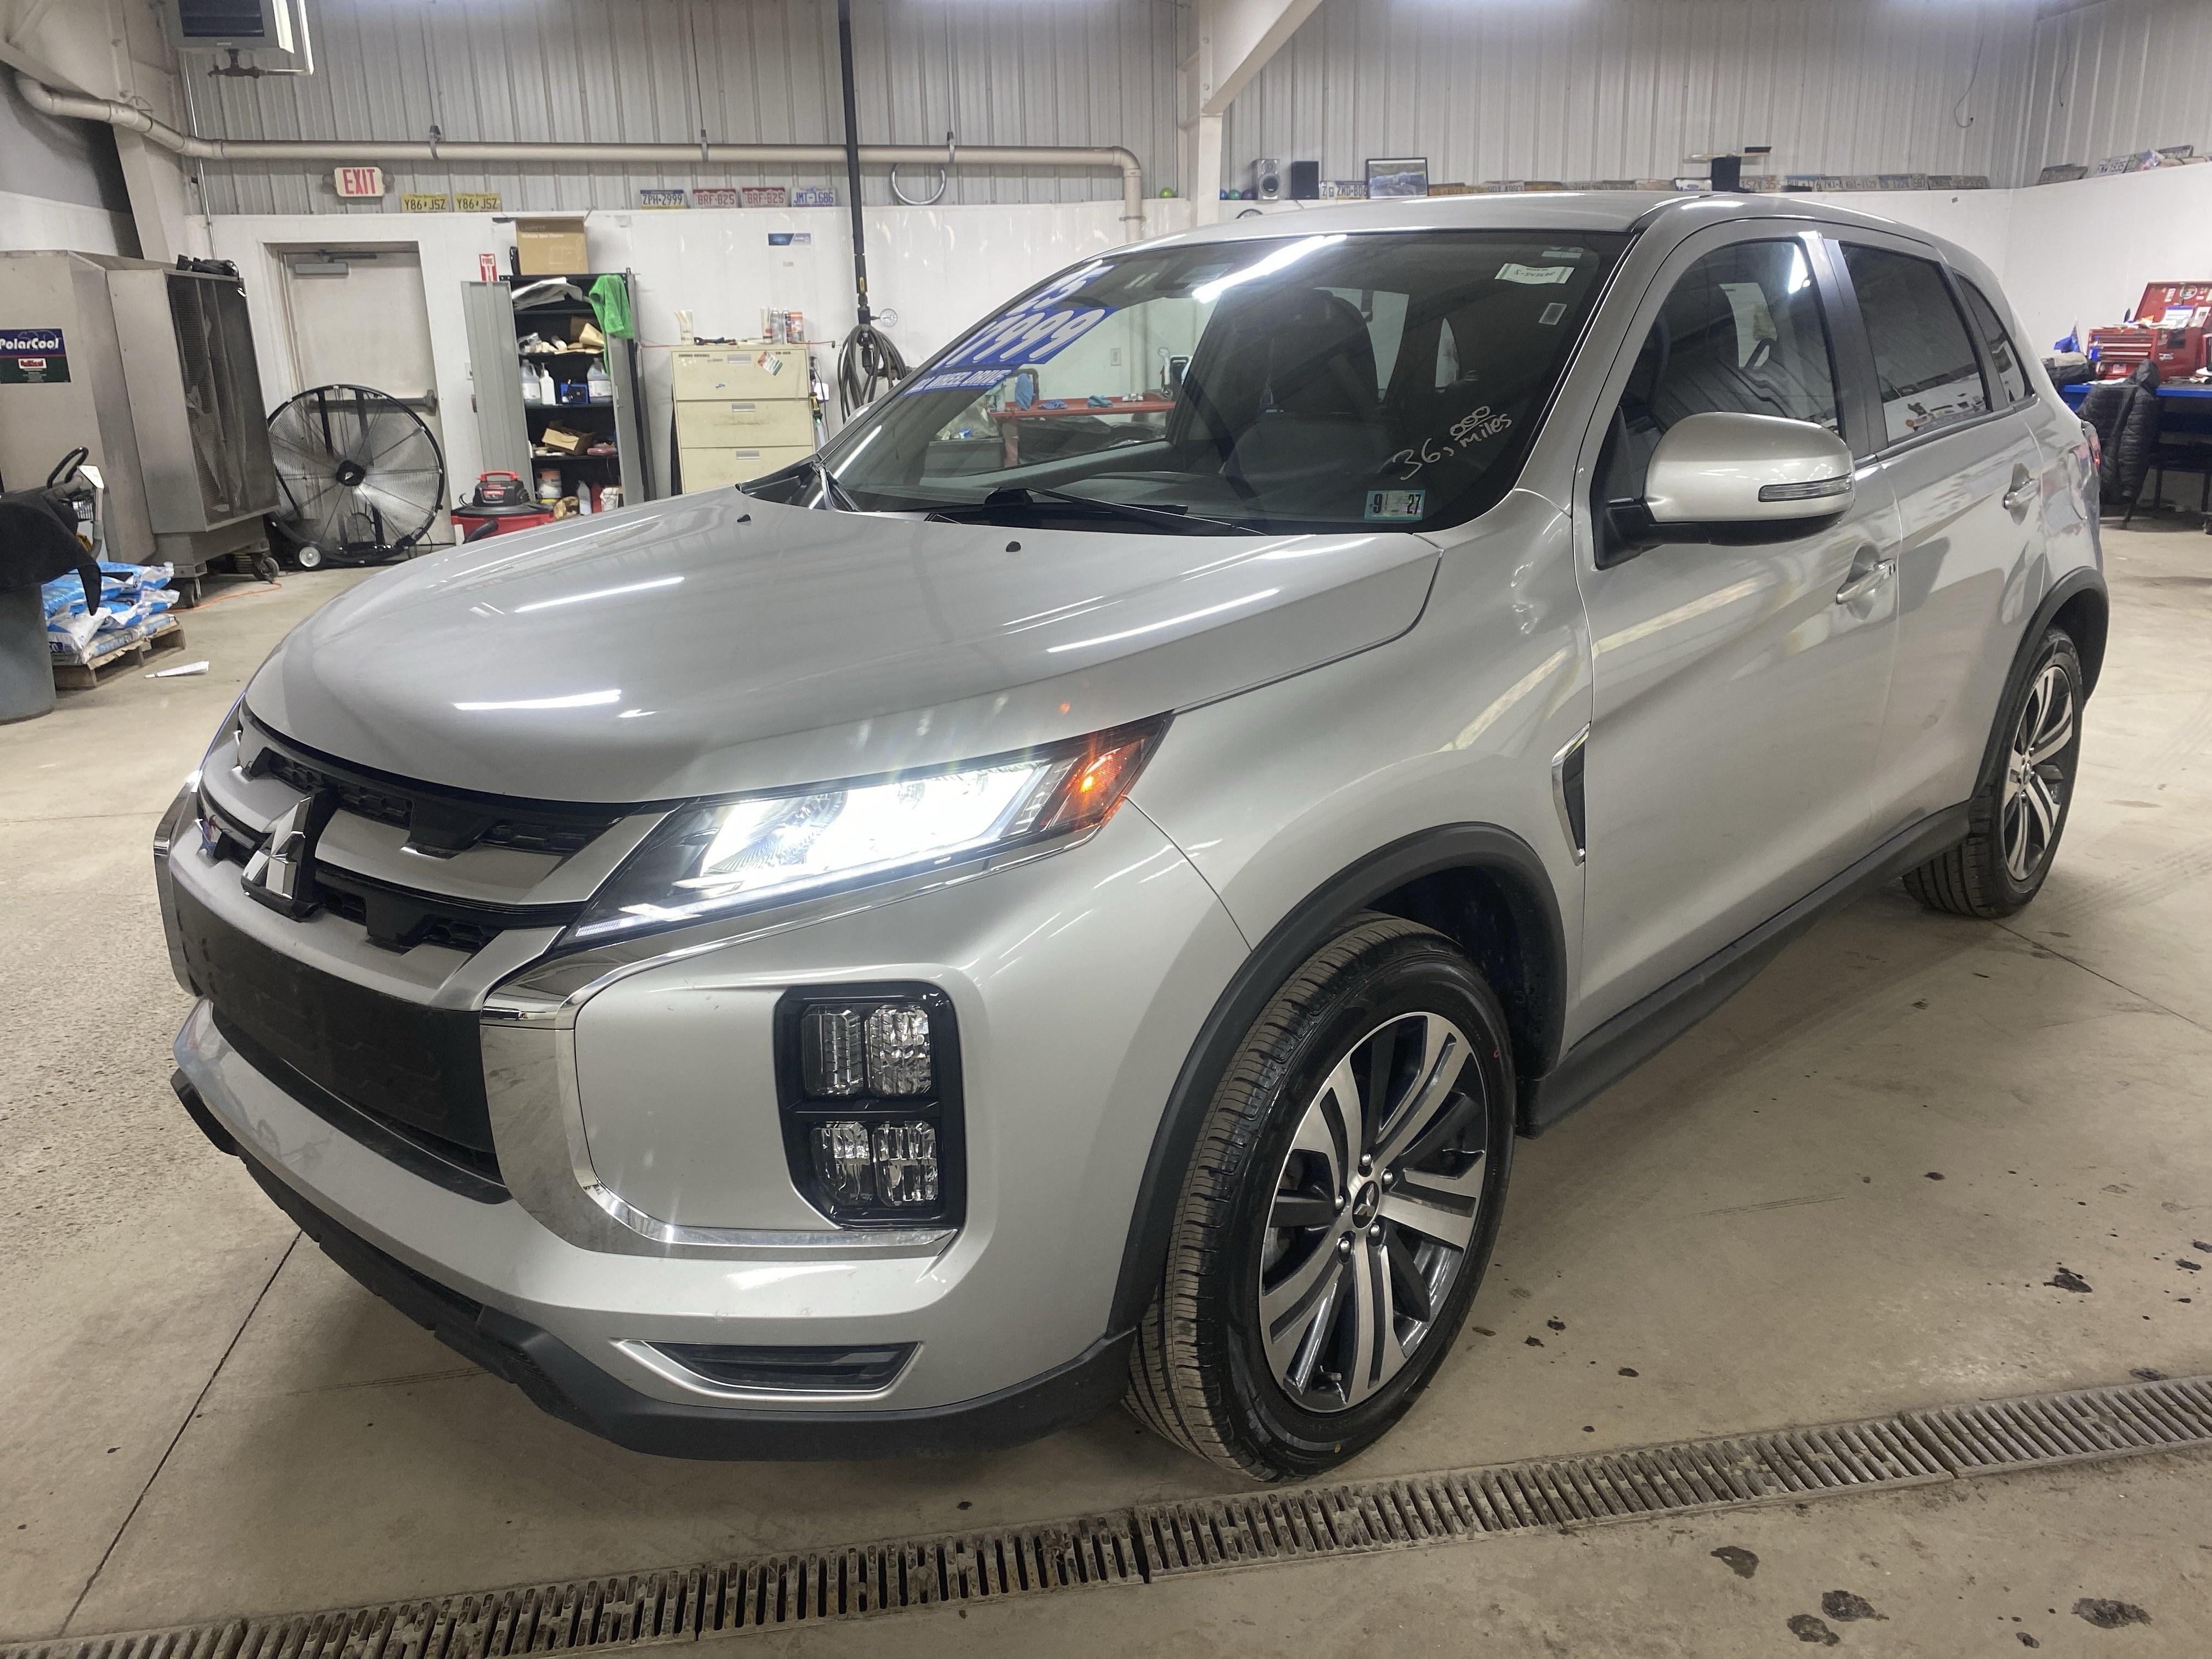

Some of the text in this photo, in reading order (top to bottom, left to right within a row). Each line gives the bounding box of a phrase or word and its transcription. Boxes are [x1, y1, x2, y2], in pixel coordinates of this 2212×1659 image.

[342, 168, 376, 195] EXIT
[0, 337, 59, 350] PolarCool
[924, 371, 973, 391] WHEEL
[960, 369, 1012, 387] DRIVE
[1459, 413, 1513, 448] miles
[1373, 493, 1383, 514] 9
[1407, 493, 1421, 515] 27
